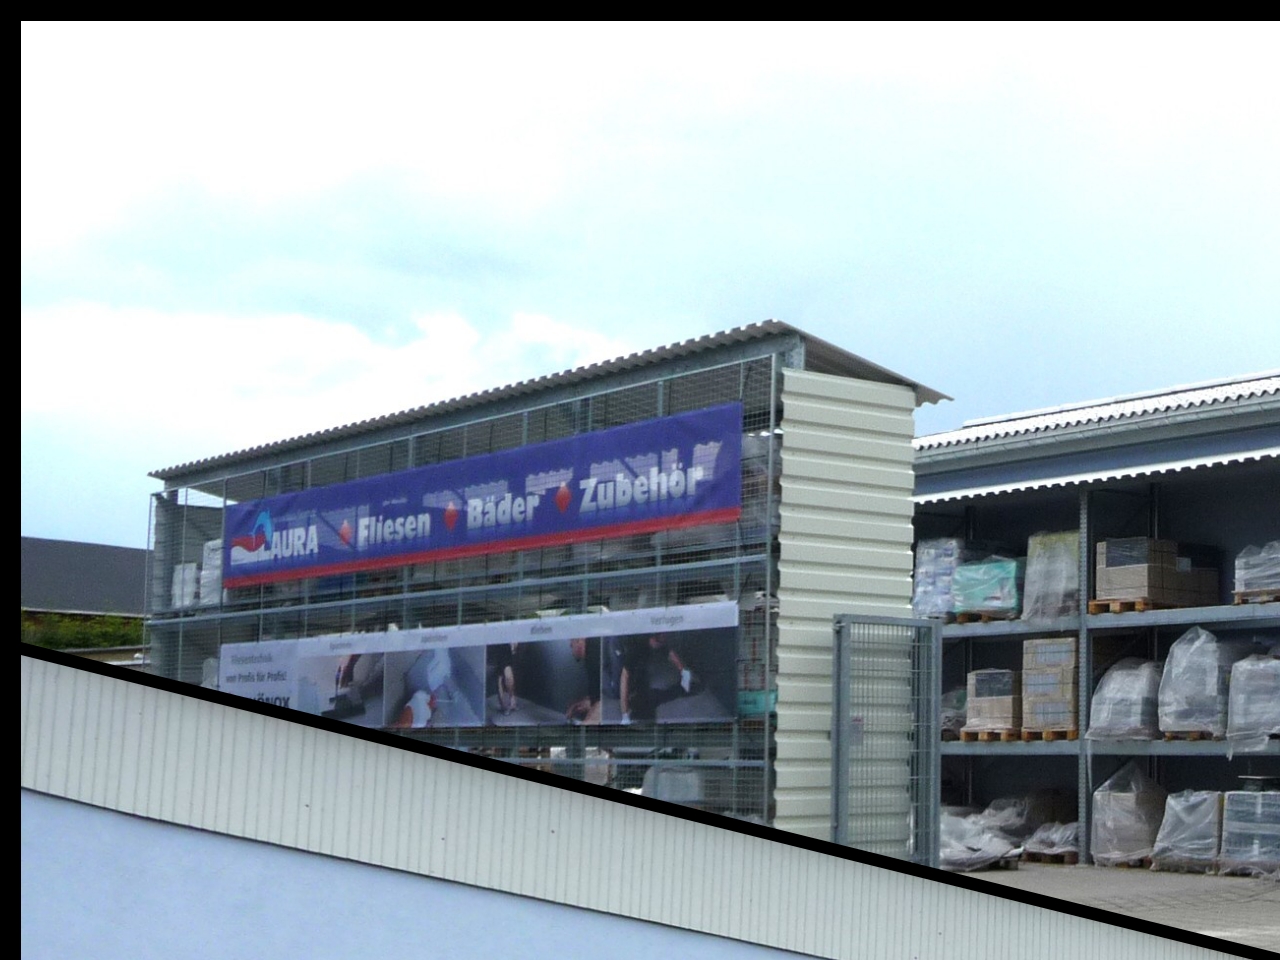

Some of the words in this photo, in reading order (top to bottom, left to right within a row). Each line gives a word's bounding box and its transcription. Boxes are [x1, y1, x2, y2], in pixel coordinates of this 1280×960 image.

[255, 526, 319, 560] LAURA
[358, 511, 431, 548] Fliesen
[466, 492, 540, 530] Bäder
[579, 459, 704, 513] Zubehör
